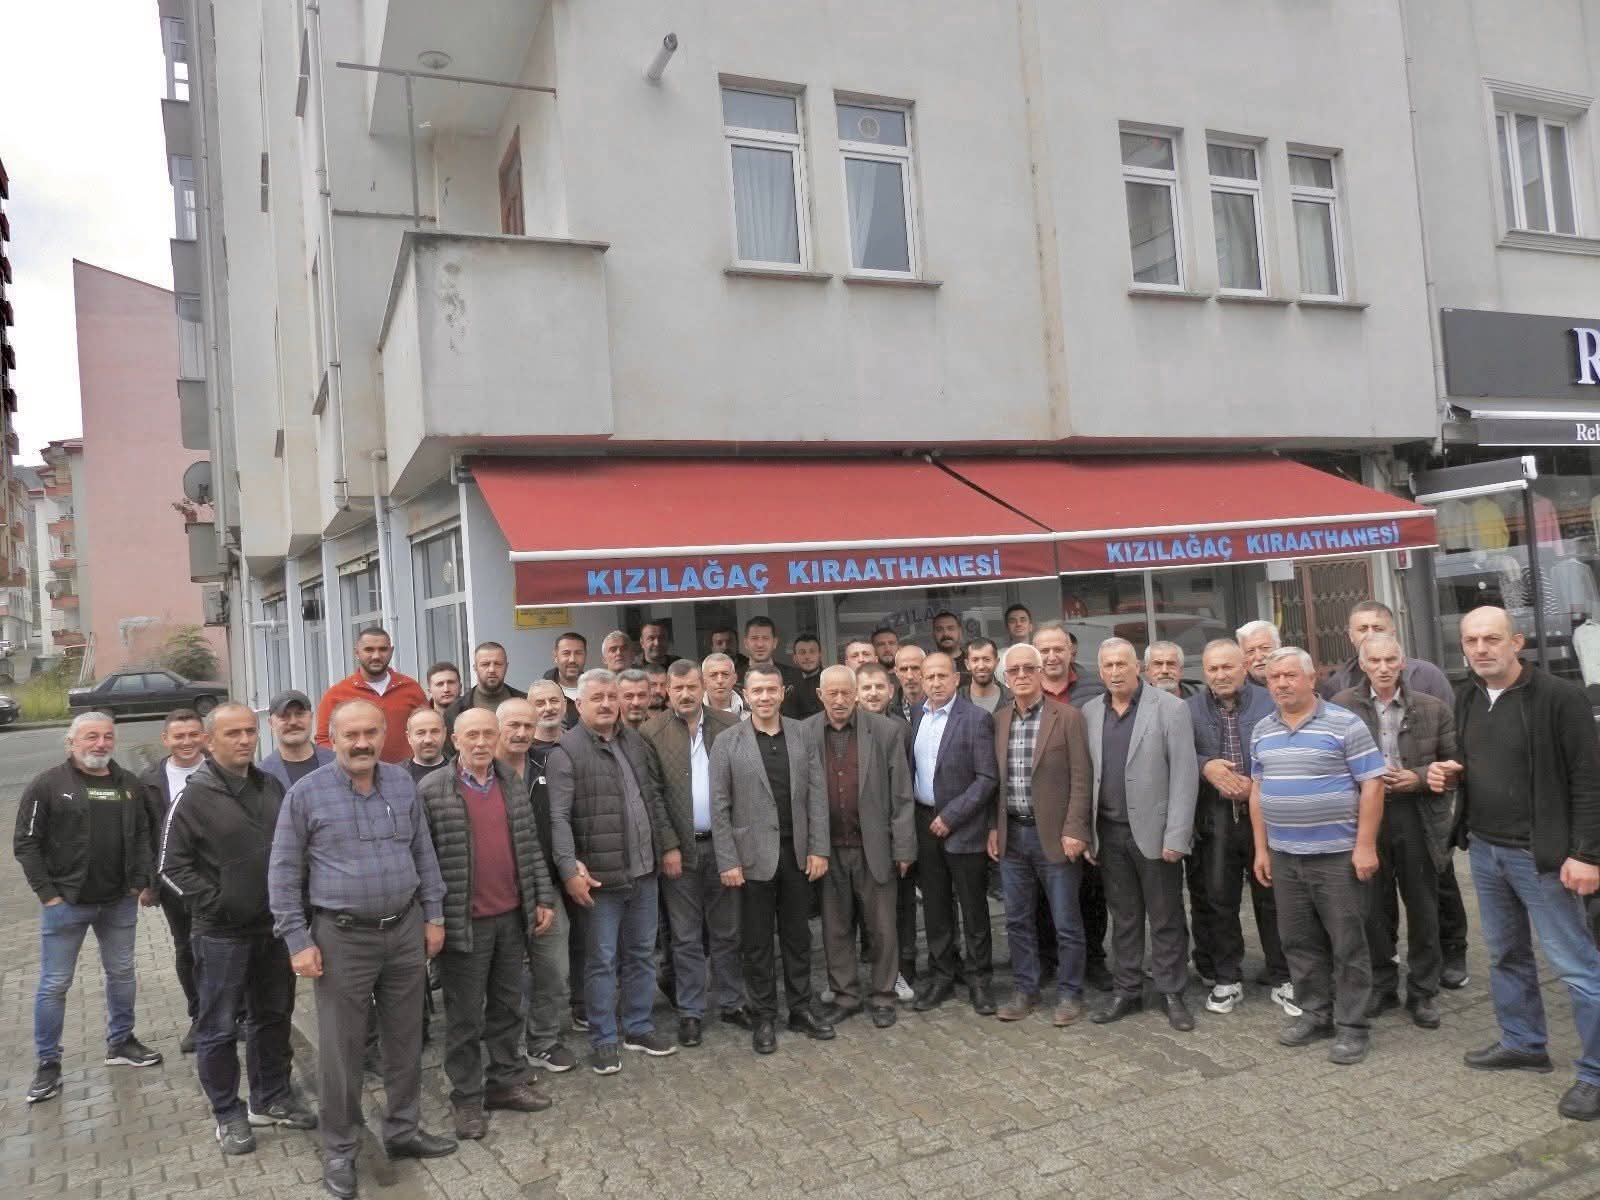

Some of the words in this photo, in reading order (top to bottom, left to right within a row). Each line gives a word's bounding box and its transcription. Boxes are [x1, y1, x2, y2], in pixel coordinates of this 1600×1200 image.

[1106, 532, 1233, 562] KIZILAĞAÇ
[1246, 521, 1399, 554] KIRAATHANESİ
[587, 560, 769, 594] KIZILAĞAÇ
[788, 549, 1001, 585] KIRAATHANESİ
